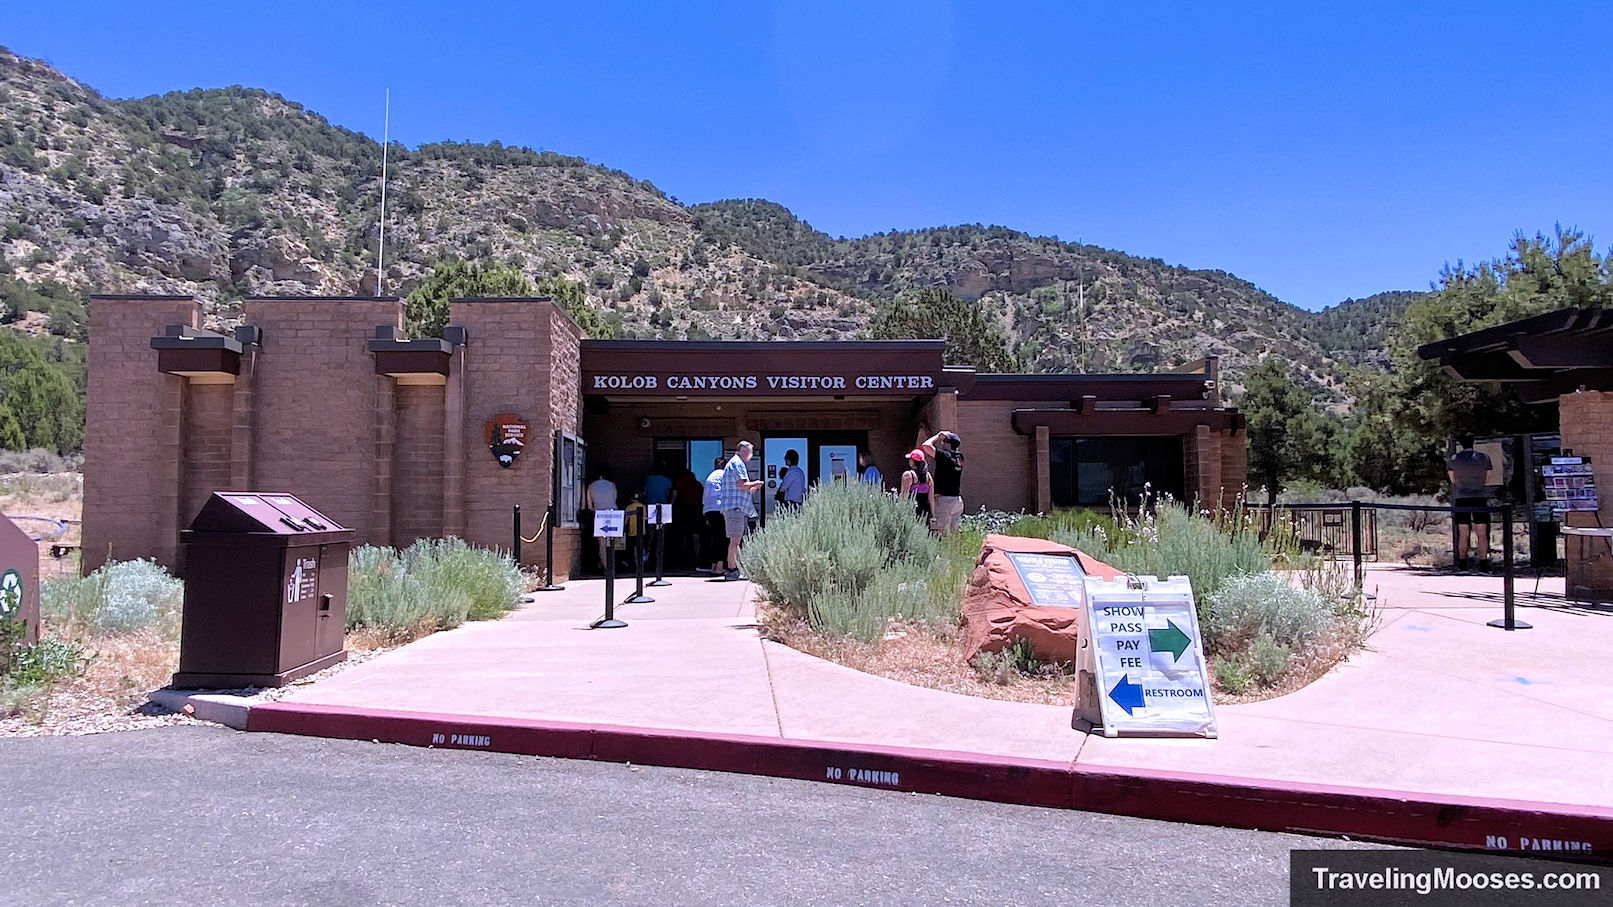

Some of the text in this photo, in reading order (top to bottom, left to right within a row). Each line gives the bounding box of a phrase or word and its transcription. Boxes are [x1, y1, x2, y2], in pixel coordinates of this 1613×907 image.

[593, 376, 934, 389] KOLOB CANYONS VISITOR CENTER
[1103, 606, 1144, 617] SHOW
[1110, 622, 1143, 633] PASS
[1116, 640, 1140, 651] PAY
[1120, 657, 1142, 668] FEE
[1145, 688, 1204, 698] RESTROOM
[432, 733, 491, 747] NO PARKING
[826, 766, 900, 786] NO PARKING
[1485, 834, 1593, 855] NO PARKING
